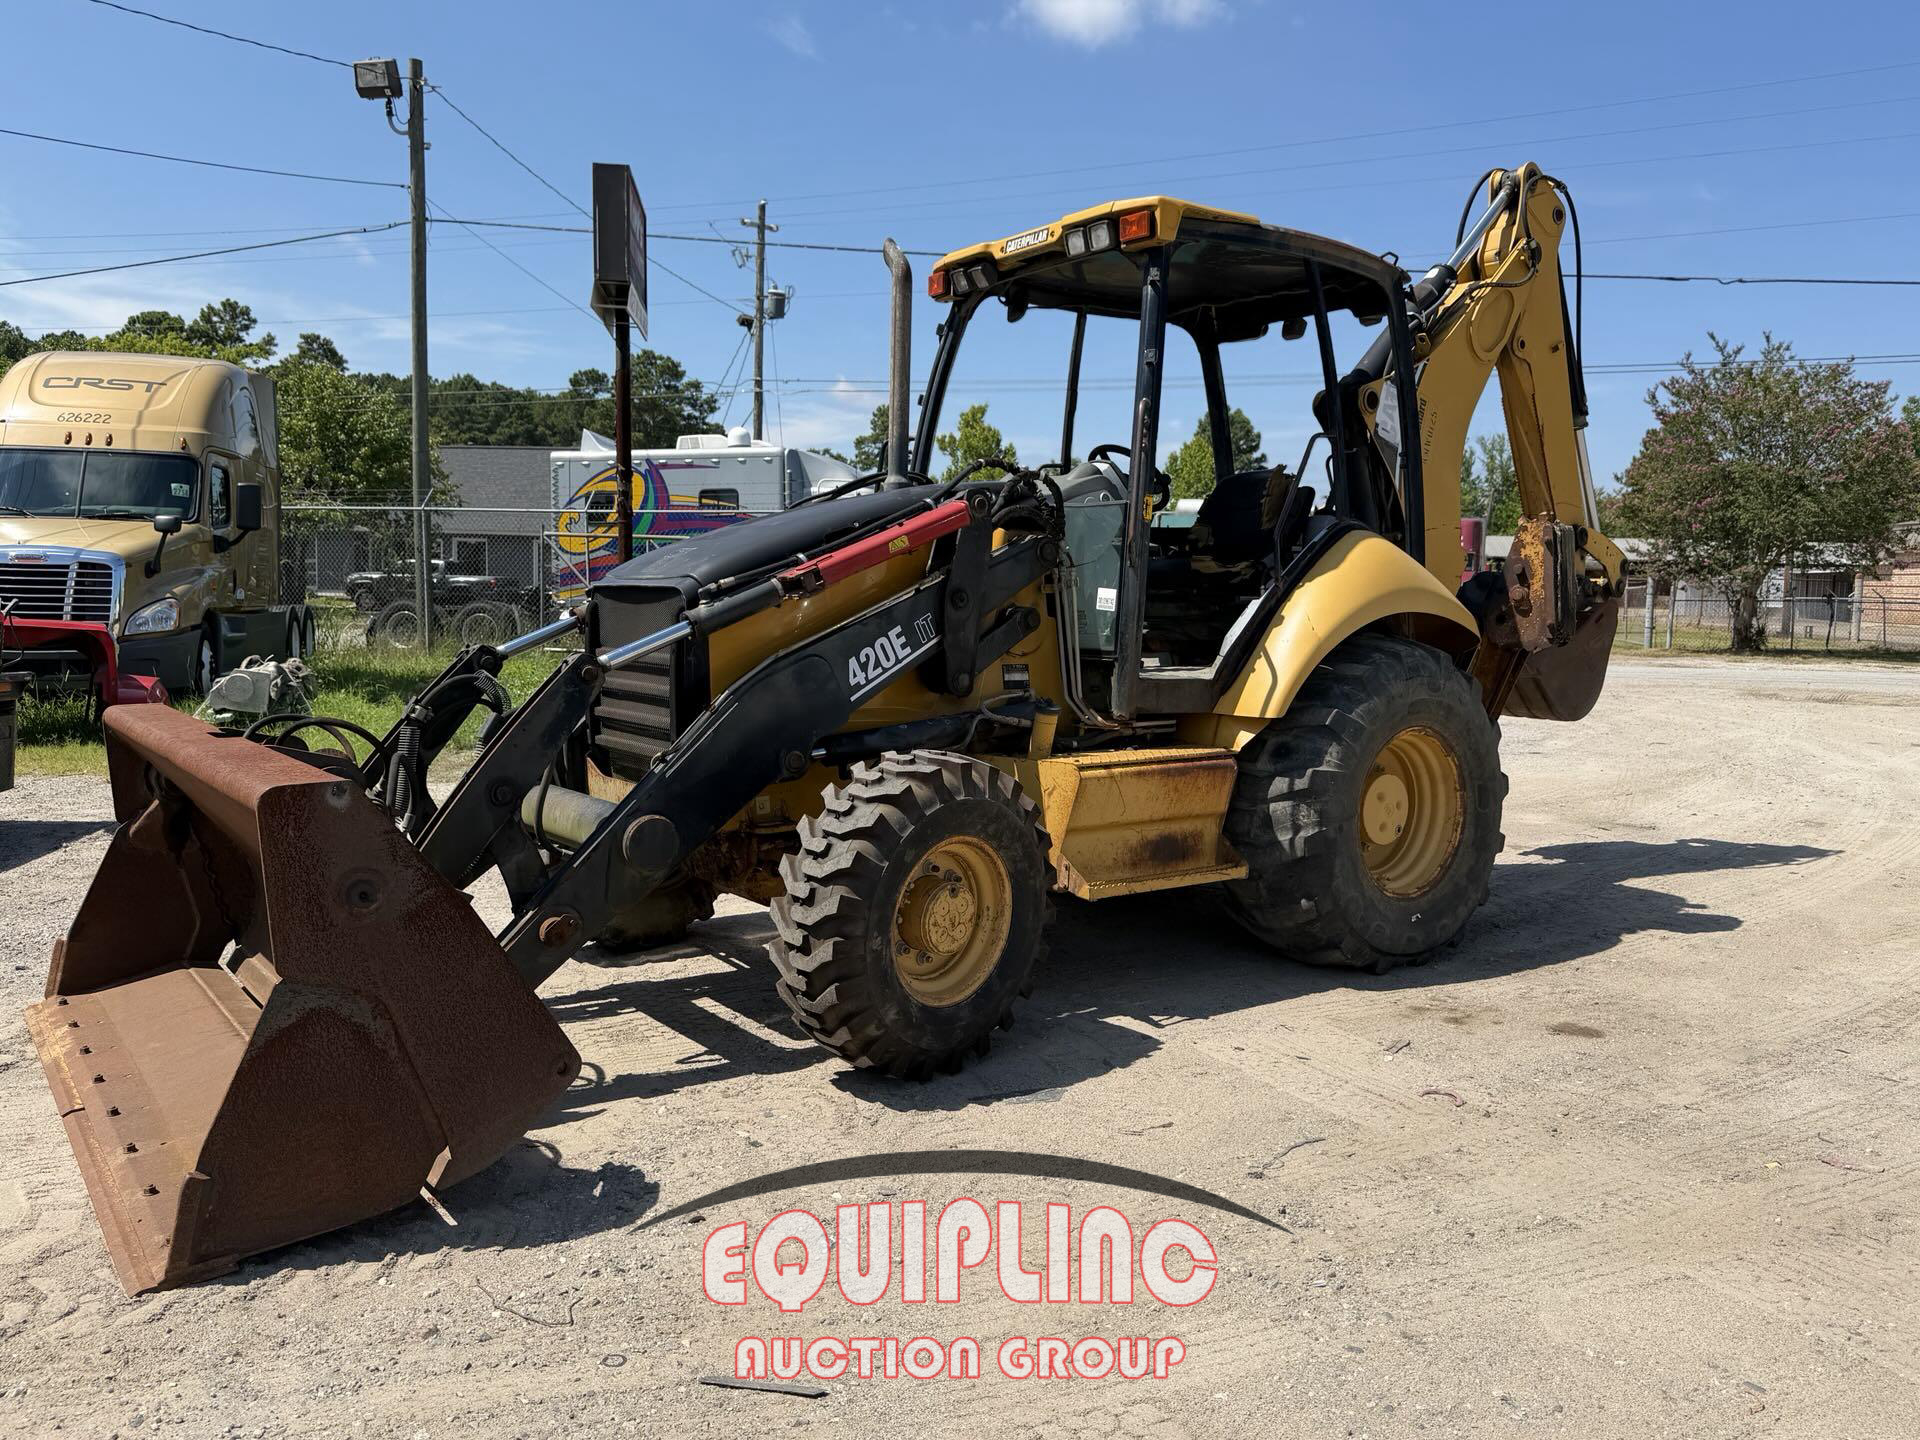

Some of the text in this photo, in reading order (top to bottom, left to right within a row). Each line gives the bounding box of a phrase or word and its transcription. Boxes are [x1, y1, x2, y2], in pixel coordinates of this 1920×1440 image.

[1007, 229, 1048, 253] CATERPILLAR
[43, 377, 167, 393] CRST
[57, 413, 112, 424] 626222
[848, 612, 936, 687] 420E IT
